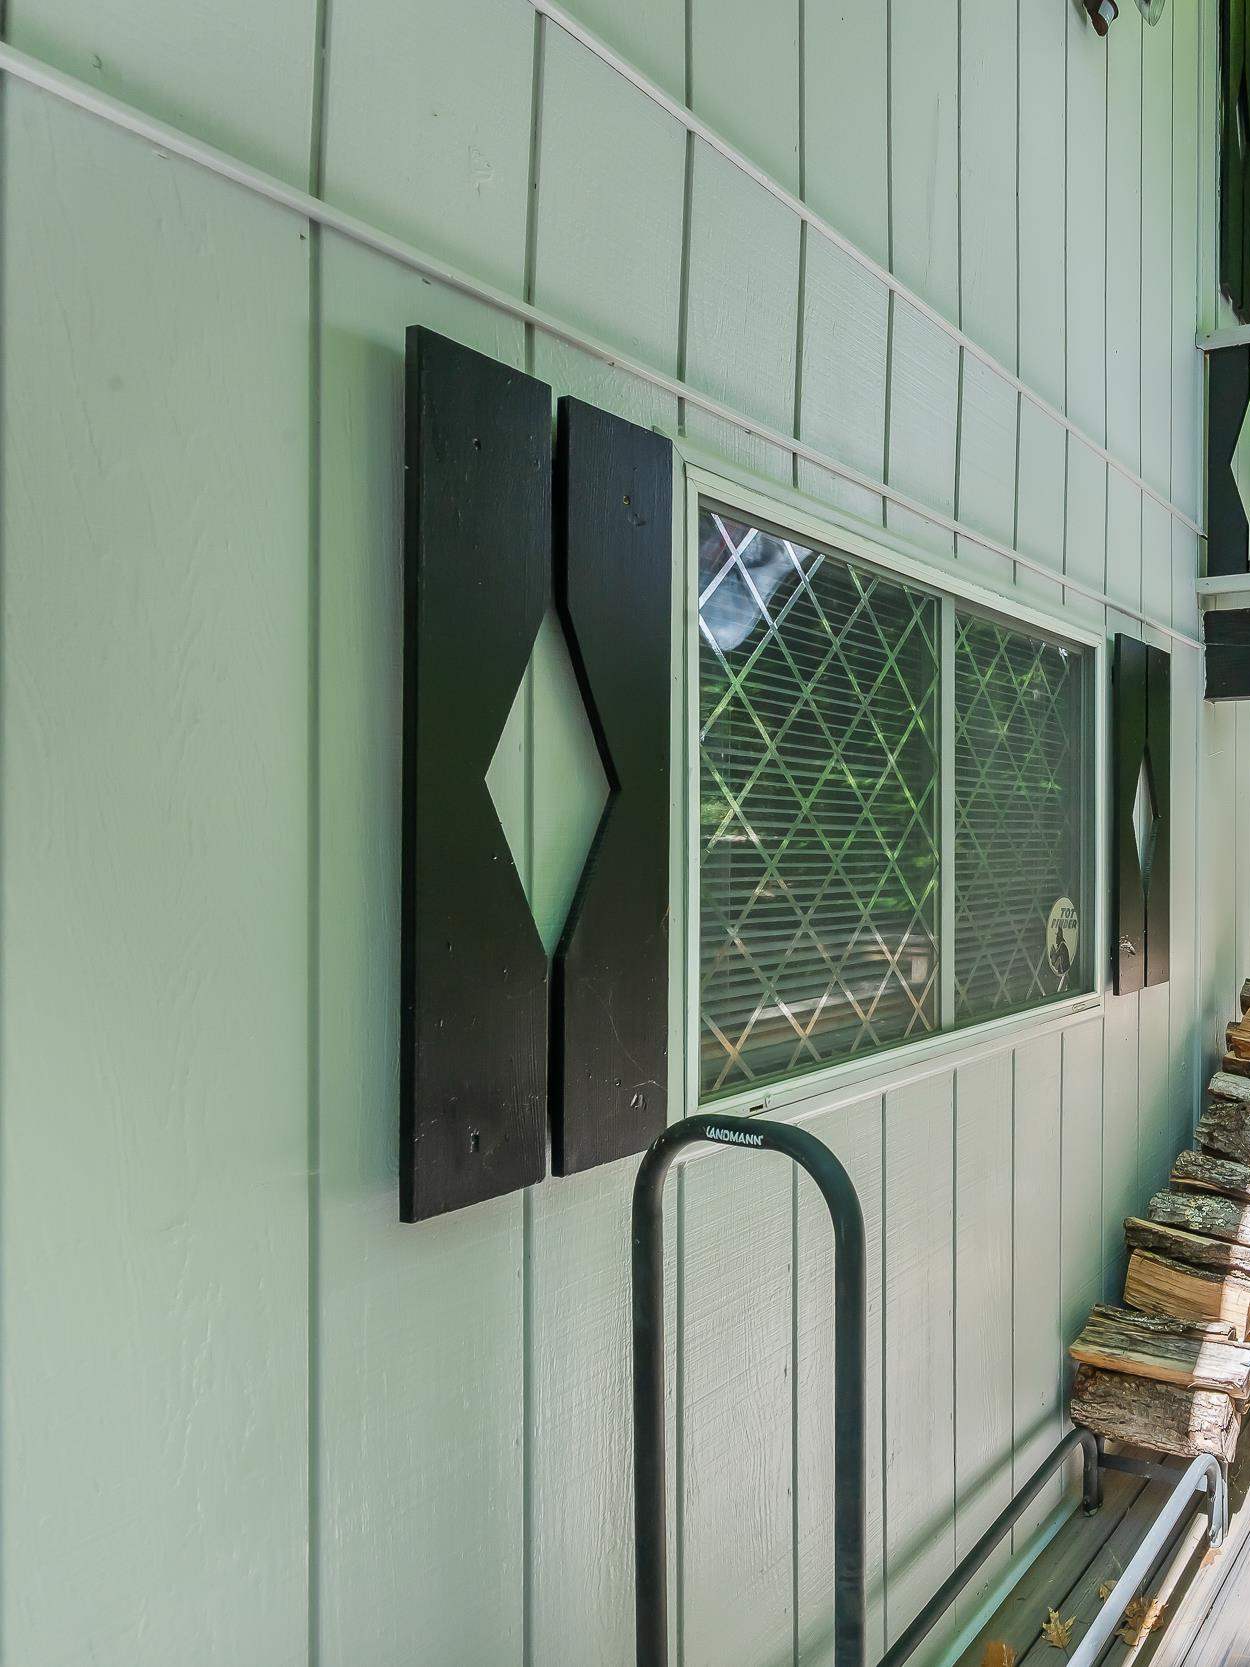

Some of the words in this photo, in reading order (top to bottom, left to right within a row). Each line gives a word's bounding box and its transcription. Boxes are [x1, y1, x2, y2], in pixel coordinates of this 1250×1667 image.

[1060, 908, 1076, 918] TOT
[1051, 918, 1077, 929] FINDER
[705, 1125, 763, 1146] LANDMANN
